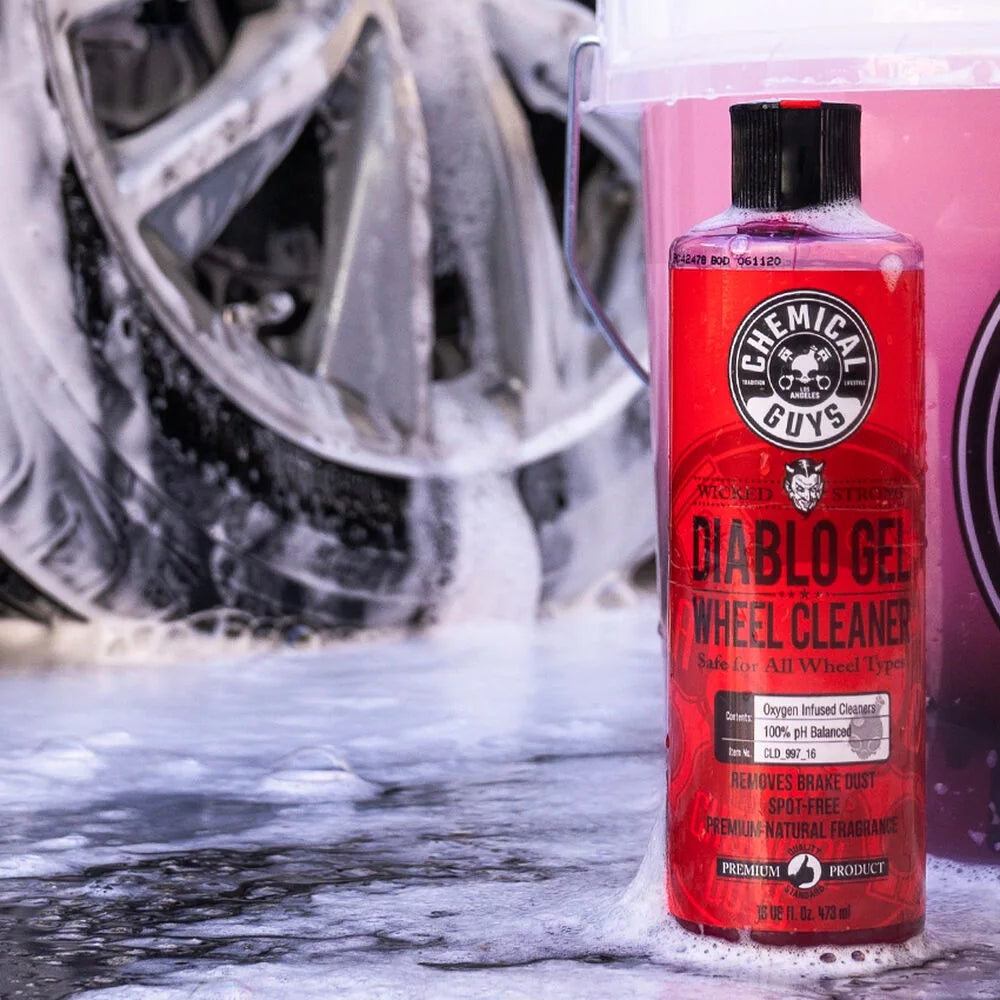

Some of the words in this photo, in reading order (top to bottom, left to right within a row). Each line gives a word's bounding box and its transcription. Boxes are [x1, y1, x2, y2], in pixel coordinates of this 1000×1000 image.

[741, 304, 867, 372] CHEMICAL
[763, 403, 845, 437] GUYS
[697, 483, 773, 500] WICKED
[832, 485, 906, 501] STRONG
[692, 515, 838, 587] DIABLO
[852, 517, 912, 586] GEL
[692, 597, 783, 649] WHEEL
[791, 598, 912, 649] CLEANER
[697, 652, 729, 670] Safe
[732, 654, 759, 672] for
[765, 657, 793, 674] All
[800, 657, 860, 674] Wheel
[863, 655, 906, 676] Types
[763, 702, 799, 718] Oxygen
[801, 702, 837, 715] Infused
[839, 702, 877, 715] Cleaners
[764, 726, 791, 738] 100%
[794, 726, 808, 740] pH
[810, 726, 852, 738] Balanced
[764, 749, 817, 761] CLD_997_16
[731, 772, 793, 791] REMOVES
[797, 773, 841, 791] BRAKE
[844, 772, 876, 790] DUST
[768, 797, 840, 815] SPOT-FREE
[830, 815, 899, 838] FRAGRANCE
[722, 861, 780, 878] PREMIUM
[829, 861, 886, 878] PRODUCT
[818, 904, 836, 921] 473
